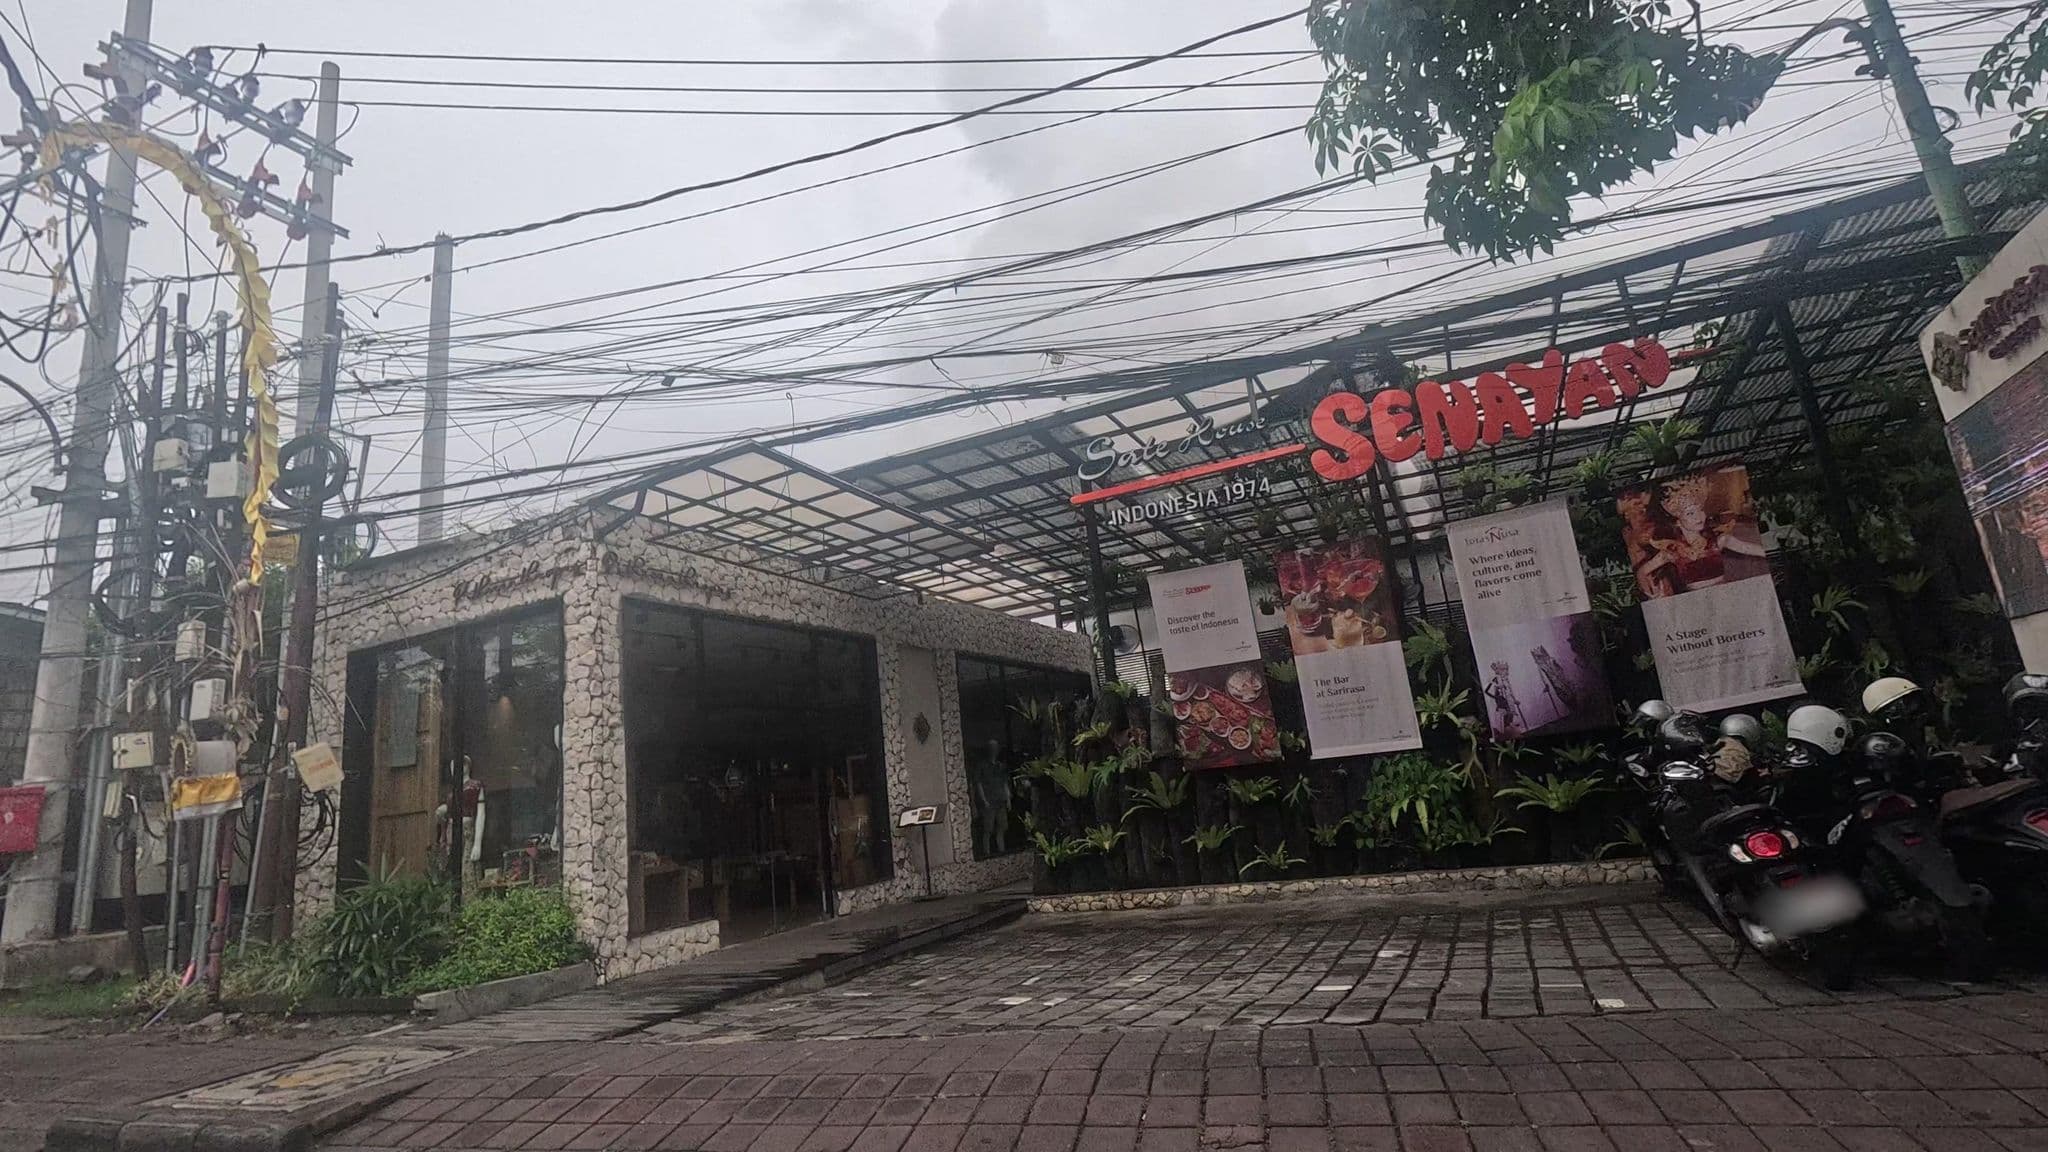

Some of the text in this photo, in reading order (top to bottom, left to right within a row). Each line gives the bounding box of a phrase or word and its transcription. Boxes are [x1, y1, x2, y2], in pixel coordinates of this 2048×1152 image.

[1311, 336, 1671, 481] SENAYAN
[1078, 415, 1266, 480] Sate House
[1110, 477, 1272, 526] INDONESIA 1974
[1469, 546, 1537, 565] Where ideas,
[1472, 557, 1535, 577] culture, and
[1474, 569, 1542, 588] flavors come
[1478, 589, 1502, 600] alive
[1167, 610, 1216, 625] Discover the
[1169, 617, 1239, 635] taste of Indonesia
[1665, 627, 1708, 642] A Stage
[1666, 628, 1766, 654] Without Borders
[1314, 676, 1350, 688] The Bar
[1316, 685, 1366, 699] at Sarirasa
